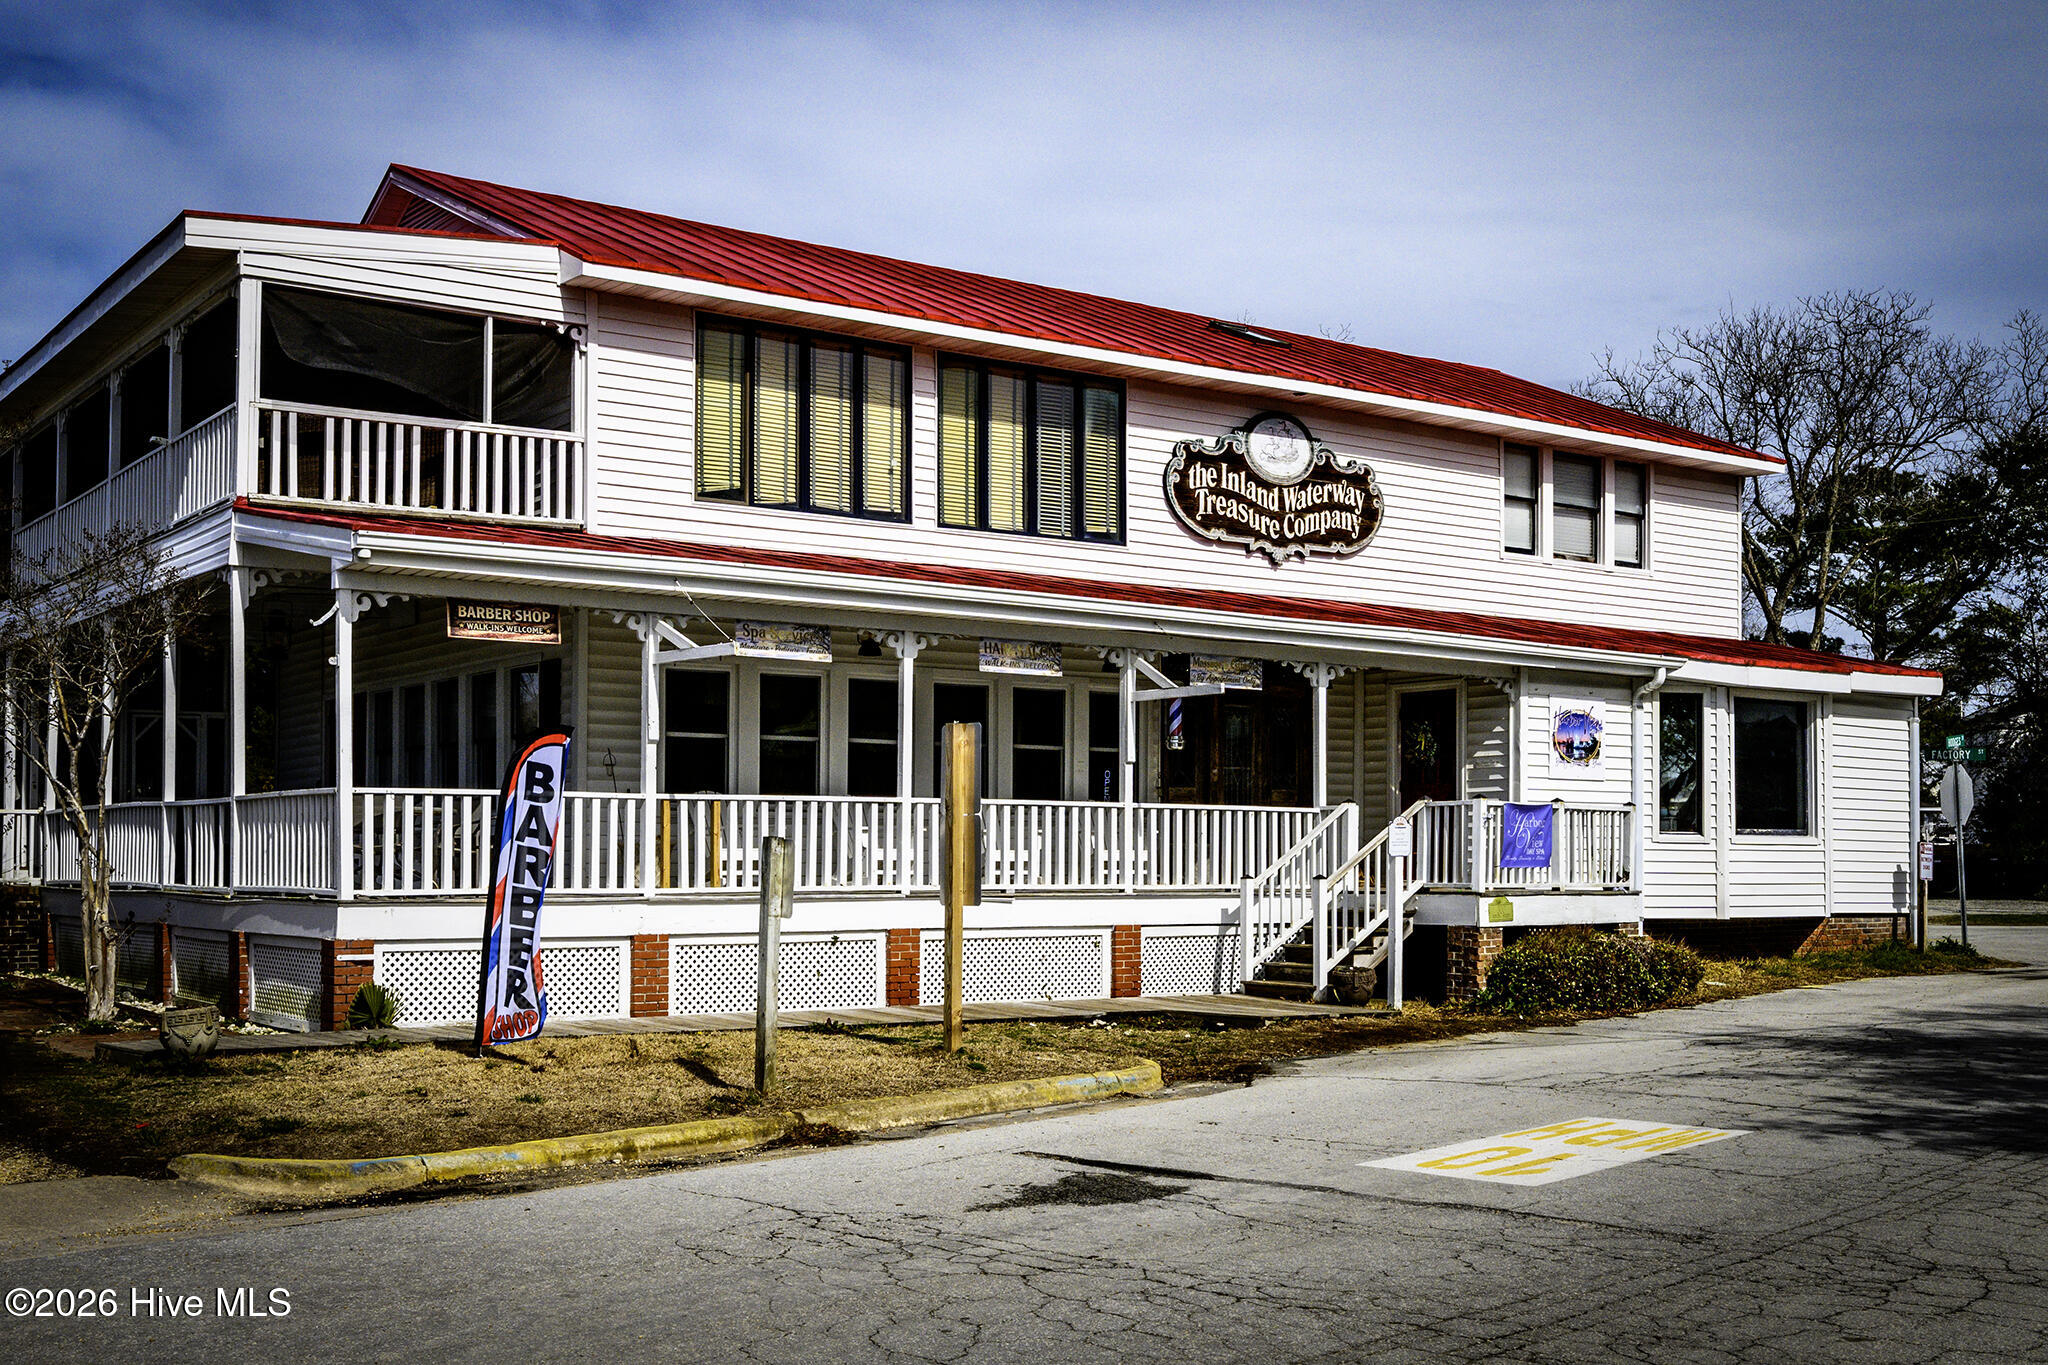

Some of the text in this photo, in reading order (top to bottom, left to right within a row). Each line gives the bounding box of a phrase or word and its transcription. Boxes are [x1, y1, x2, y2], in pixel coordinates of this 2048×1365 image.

[1188, 461, 1366, 516] the Inland Waterway
[1195, 488, 1362, 540] Treasure Company
[457, 604, 552, 624] BARBER SHOP
[465, 621, 545, 635] WALK-INS WELCOME
[742, 623, 824, 643] Spa Services
[984, 641, 1057, 661] HAIR SALON
[1931, 749, 1971, 760] FACTORY
[1507, 809, 1546, 838] Harbor
[1515, 828, 1545, 853] View
[504, 759, 556, 1011] BARBER
[493, 1010, 539, 1041] SHOP
